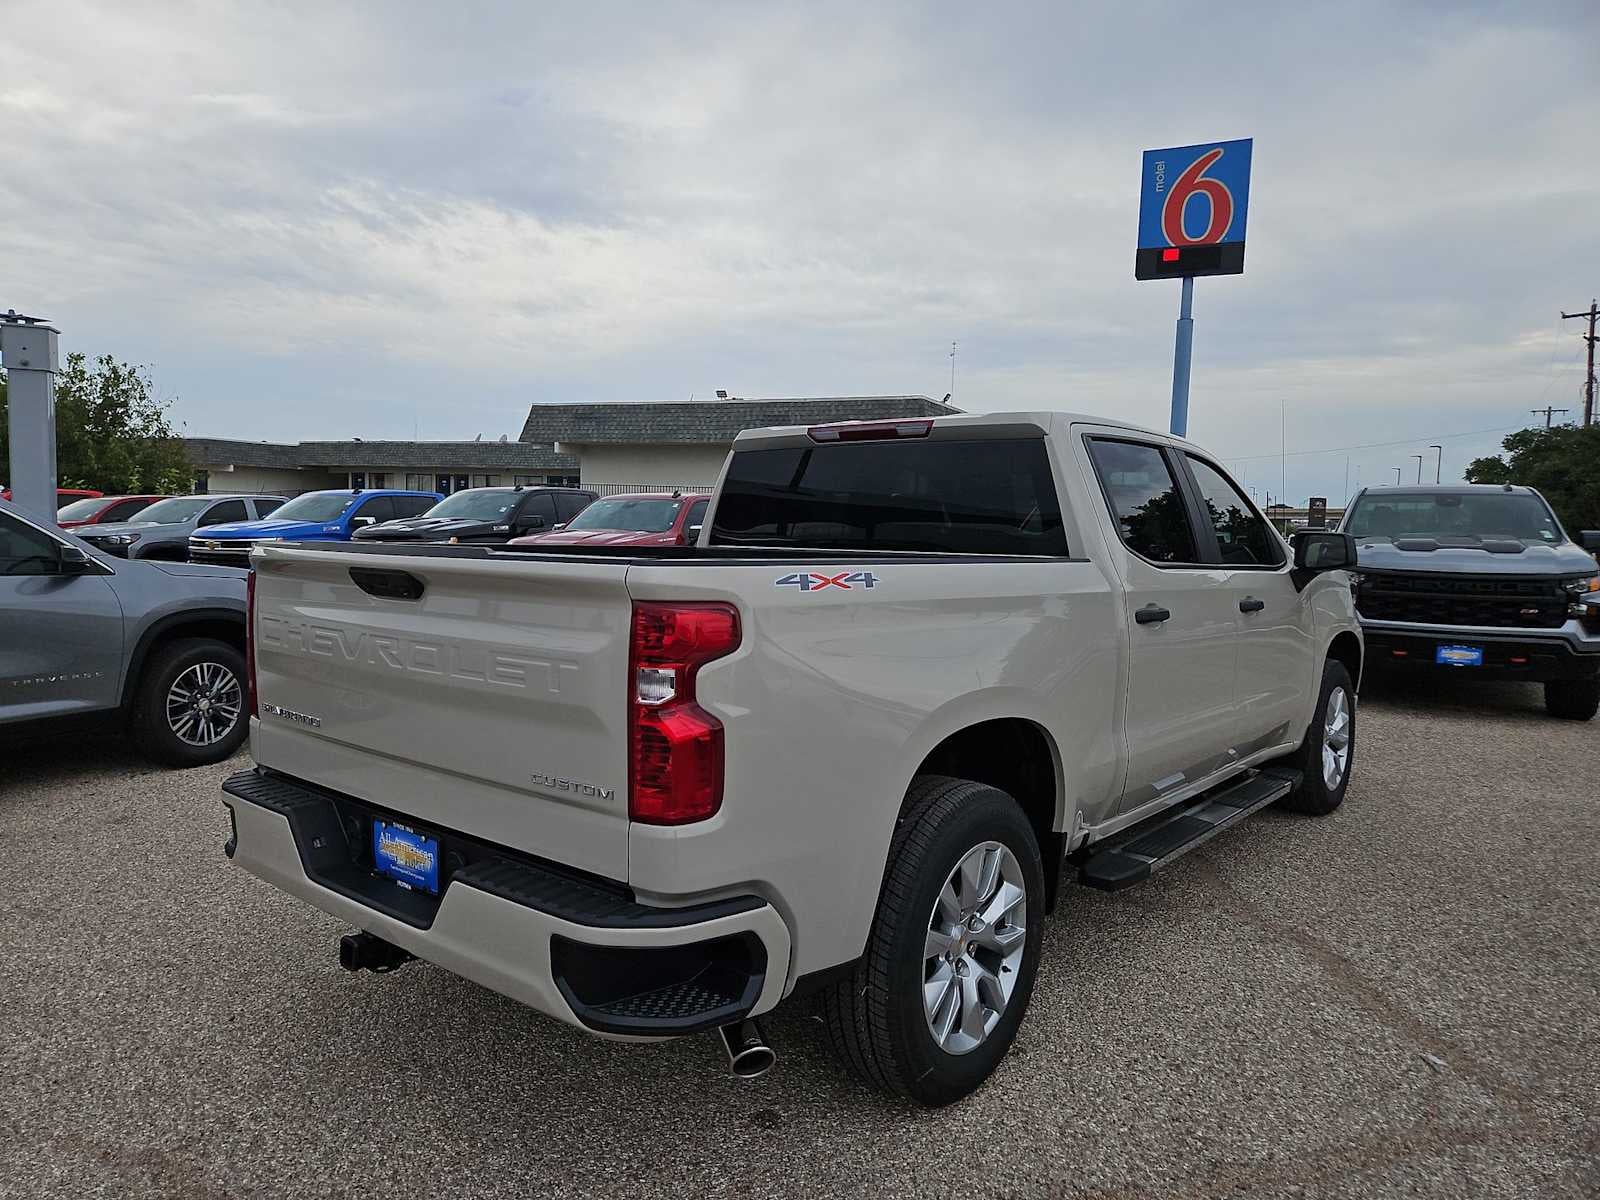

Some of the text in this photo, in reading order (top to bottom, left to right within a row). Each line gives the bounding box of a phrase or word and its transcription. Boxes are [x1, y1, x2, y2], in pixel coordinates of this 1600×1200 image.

[1155, 161, 1165, 192] motel
[1161, 148, 1234, 246] 6
[262, 616, 579, 693] CHEVROLET
[531, 773, 616, 801] CUSTOM
